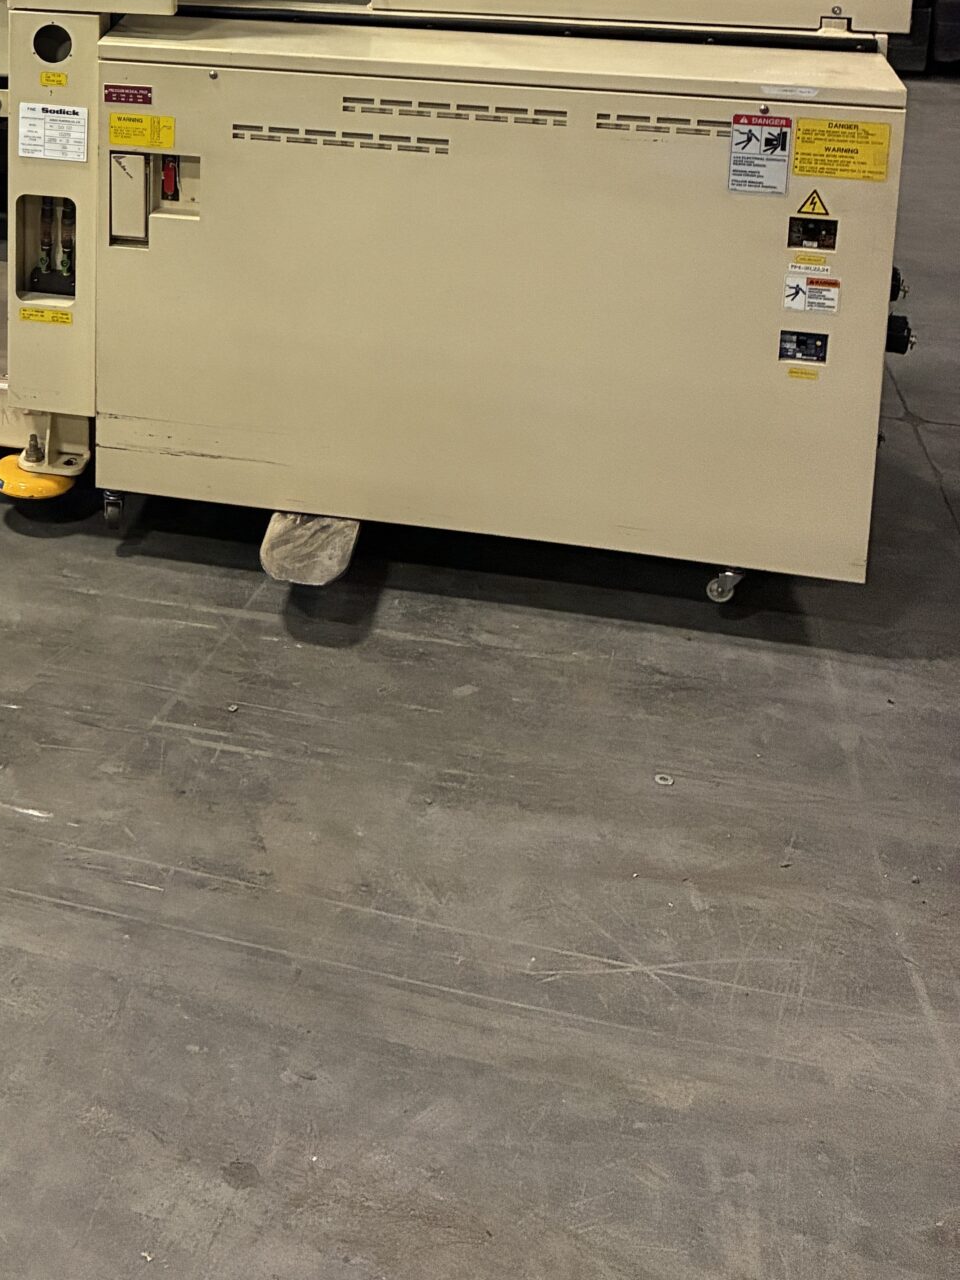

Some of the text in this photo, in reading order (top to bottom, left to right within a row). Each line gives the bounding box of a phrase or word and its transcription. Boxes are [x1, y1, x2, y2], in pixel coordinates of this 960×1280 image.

[42, 107, 80, 116] Sodick
[752, 117, 786, 125] DANGER
[828, 122, 858, 130] DANGER
[824, 146, 858, 154] WARNING
